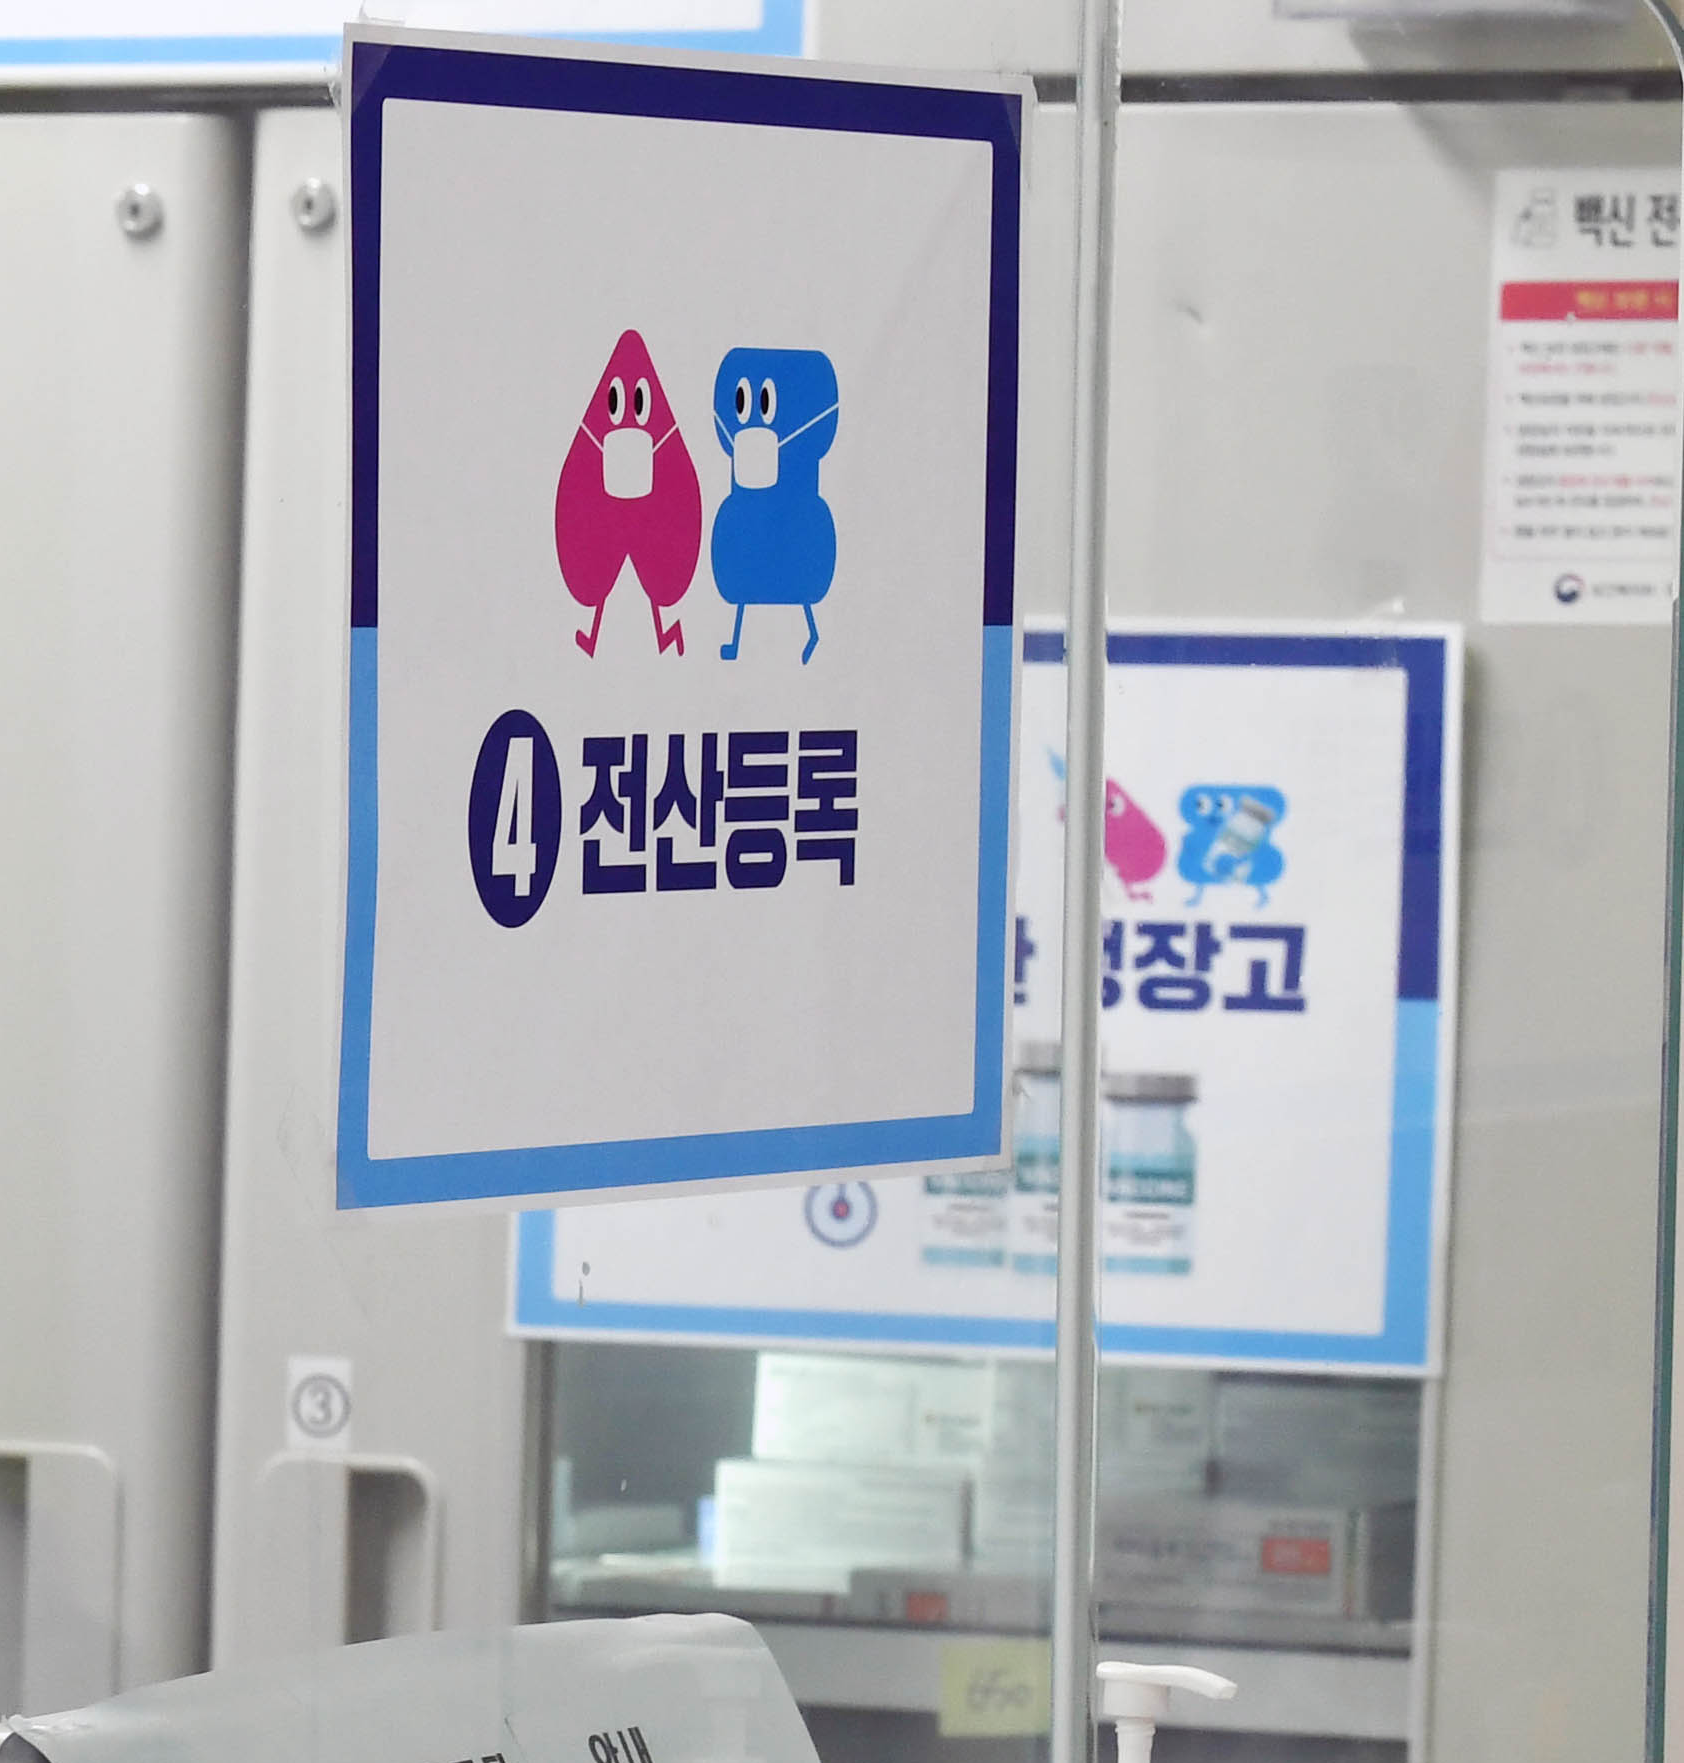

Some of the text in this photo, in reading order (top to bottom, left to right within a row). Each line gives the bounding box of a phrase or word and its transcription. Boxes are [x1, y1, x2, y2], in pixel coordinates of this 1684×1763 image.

[1574, 194, 1636, 247] 백신
[491, 729, 859, 897] 4 전산등록
